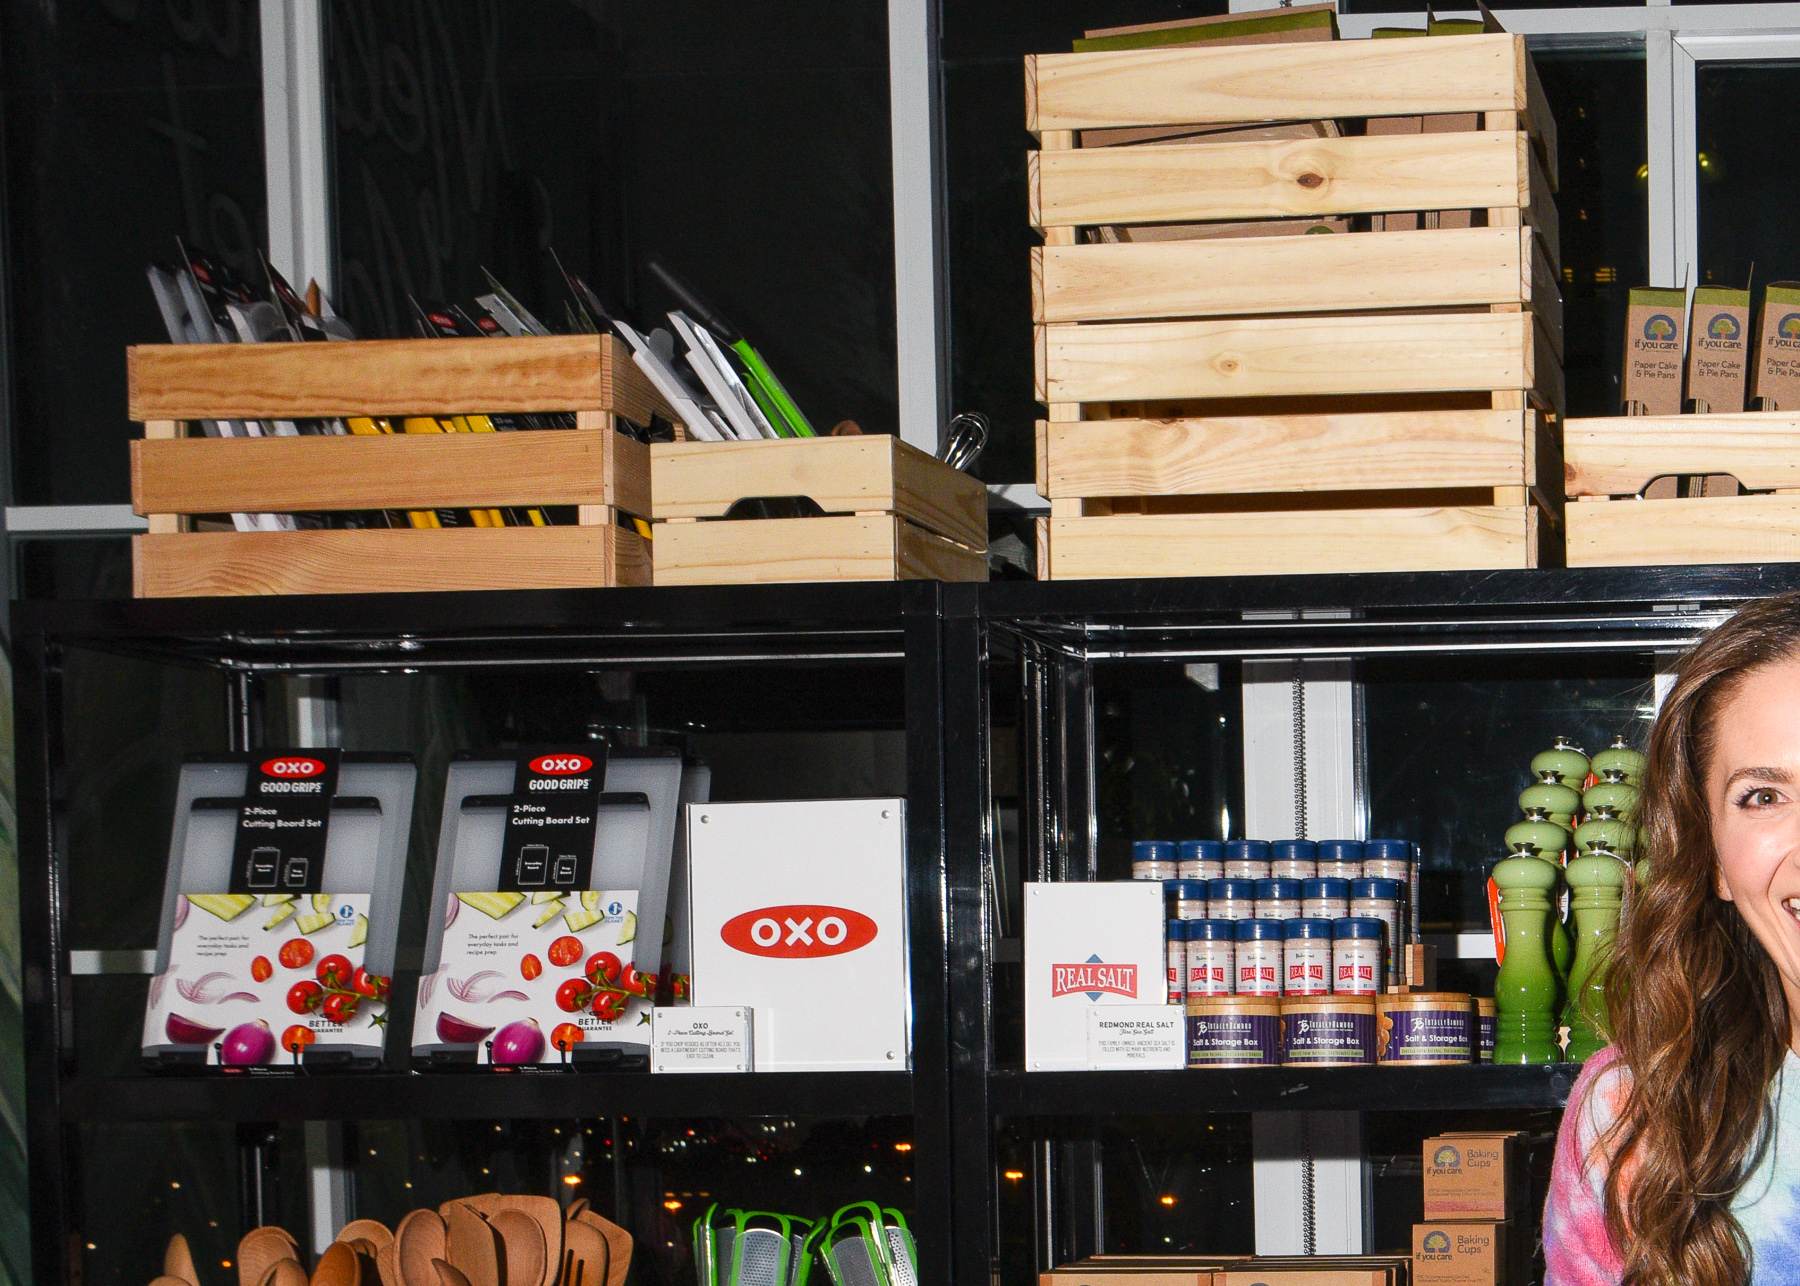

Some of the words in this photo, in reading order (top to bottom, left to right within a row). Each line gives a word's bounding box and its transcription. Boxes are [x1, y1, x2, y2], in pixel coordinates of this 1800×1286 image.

[1768, 336, 1774, 346] if
[1774, 339, 1791, 349] you
[1767, 357, 1790, 368] Paper
[1767, 367, 1774, 375] &
[1775, 368, 1787, 376] Pie
[273, 762, 314, 774] OXO
[541, 759, 581, 771] OXO
[529, 779, 559, 790] GOOD
[560, 778, 589, 790] GRIPS
[514, 805, 546, 813] 2-Piece
[512, 816, 544, 827] Cutting
[546, 816, 574, 825] Board
[575, 816, 590, 824] Set
[750, 917, 847, 947] OXO
[1056, 967, 1095, 992] REAL
[1097, 968, 1134, 992] SALT
[692, 1022, 709, 1030] OXO
[1193, 1038, 1204, 1046] Salt
[1211, 1038, 1242, 1047] Storage
[1244, 1038, 1258, 1046] Box
[1457, 1235, 1490, 1246] Baking
[1457, 1245, 1482, 1255] Cups
